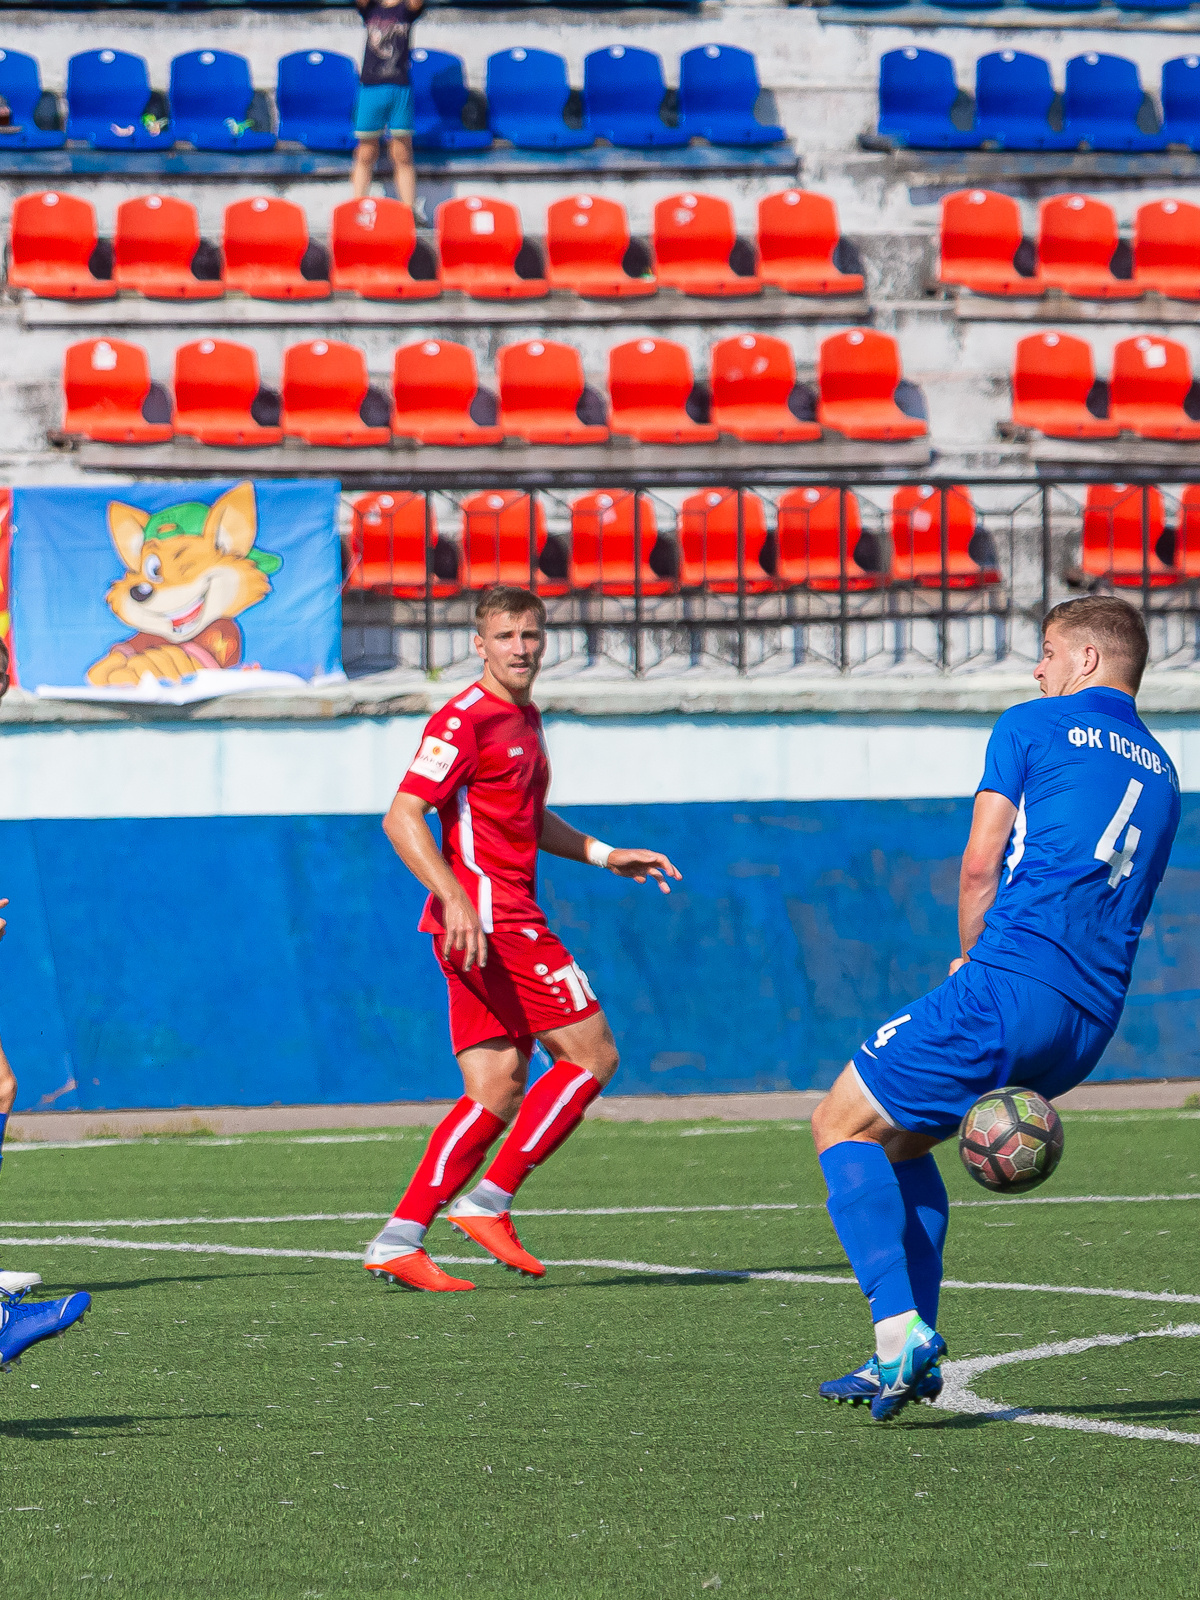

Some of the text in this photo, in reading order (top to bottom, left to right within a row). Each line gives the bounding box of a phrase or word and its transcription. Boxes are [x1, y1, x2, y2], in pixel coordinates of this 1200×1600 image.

[1068, 727, 1180, 795] ФК ПСКОВ-7
[1094, 778, 1144, 889] 4
[874, 1014, 912, 1049] 4
